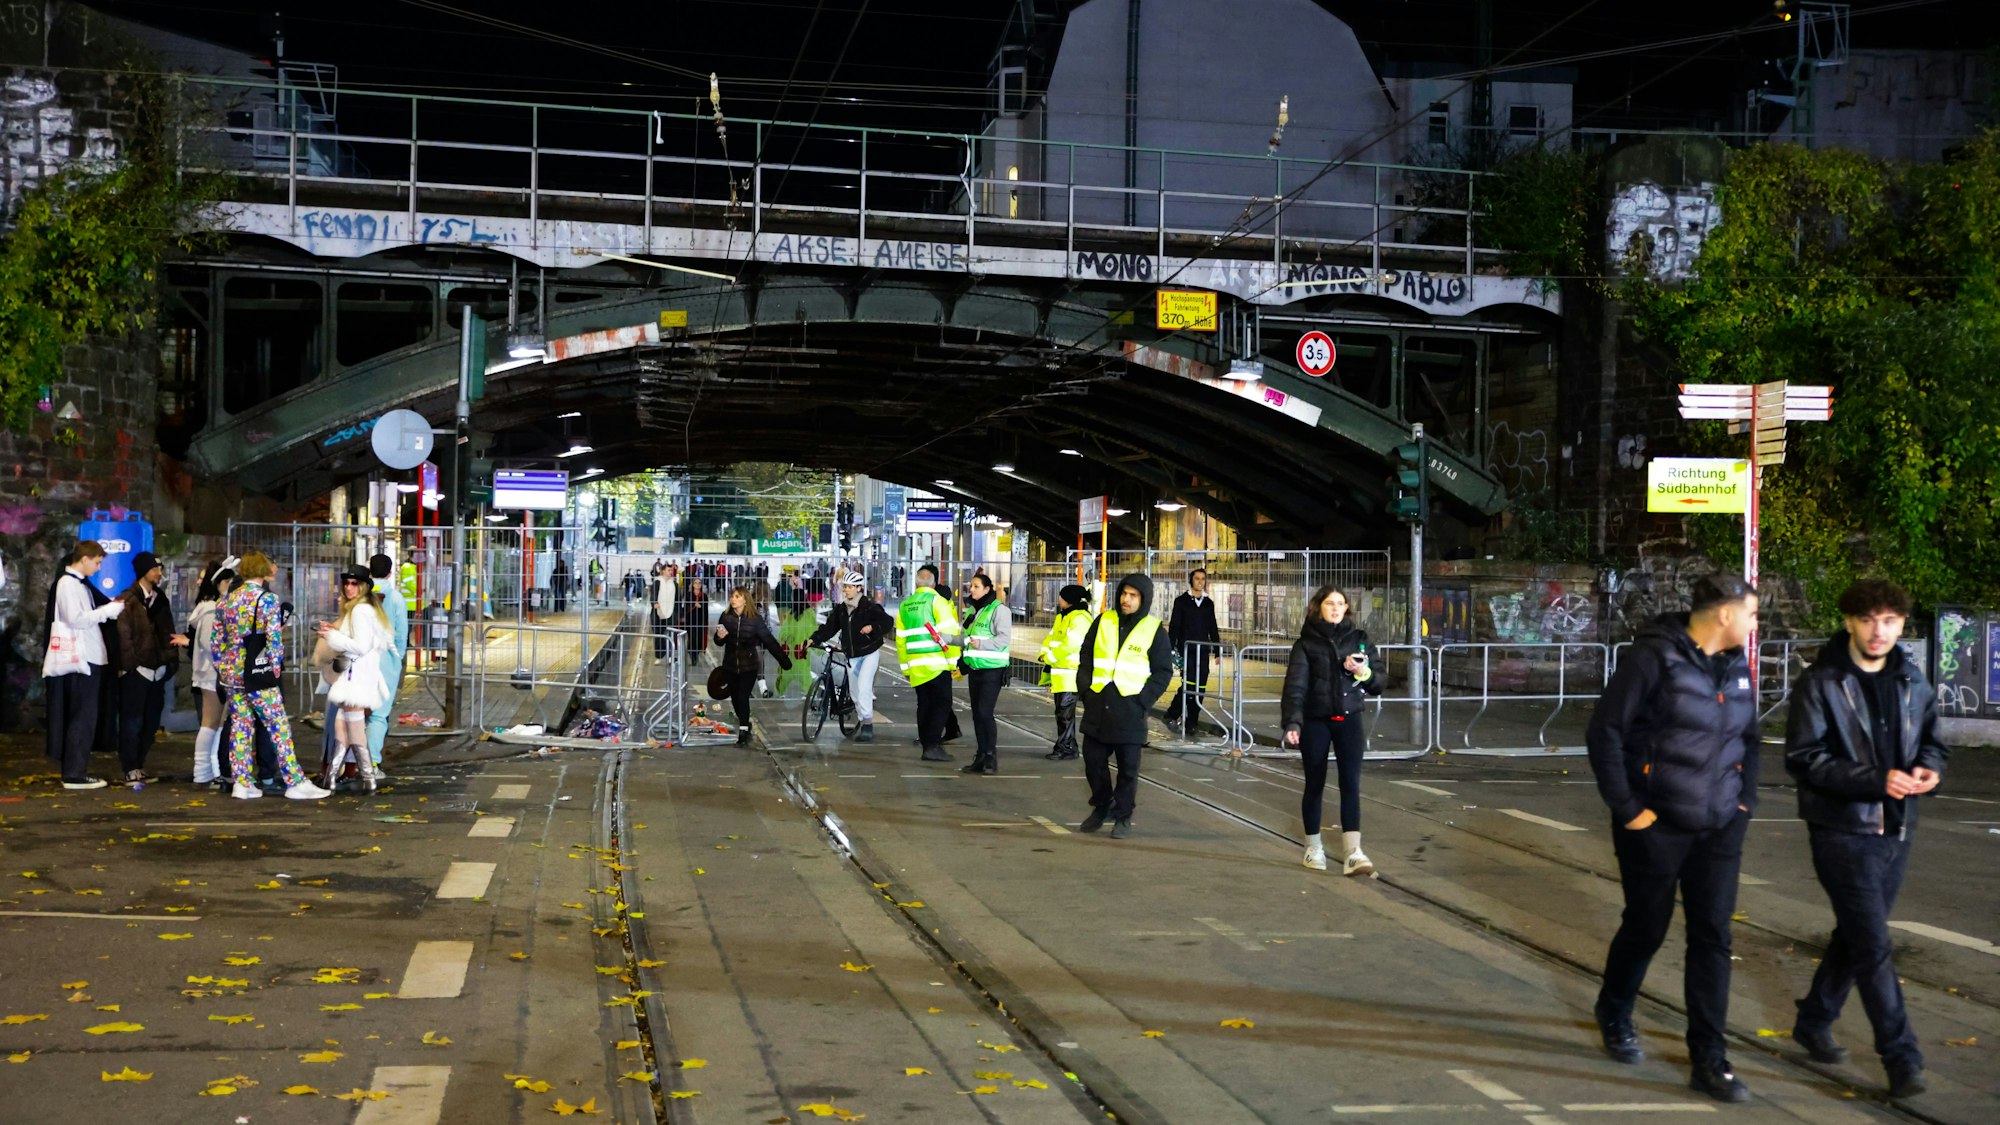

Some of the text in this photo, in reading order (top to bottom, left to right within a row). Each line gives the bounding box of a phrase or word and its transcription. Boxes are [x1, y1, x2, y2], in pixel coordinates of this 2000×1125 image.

[874, 239, 963, 270] AMEISE
[1076, 251, 1152, 281] MONO
[1285, 264, 1467, 305] MONO PABLO
[1657, 482, 1737, 495] Südbahnhof
[1668, 467, 1726, 481] Richtung
